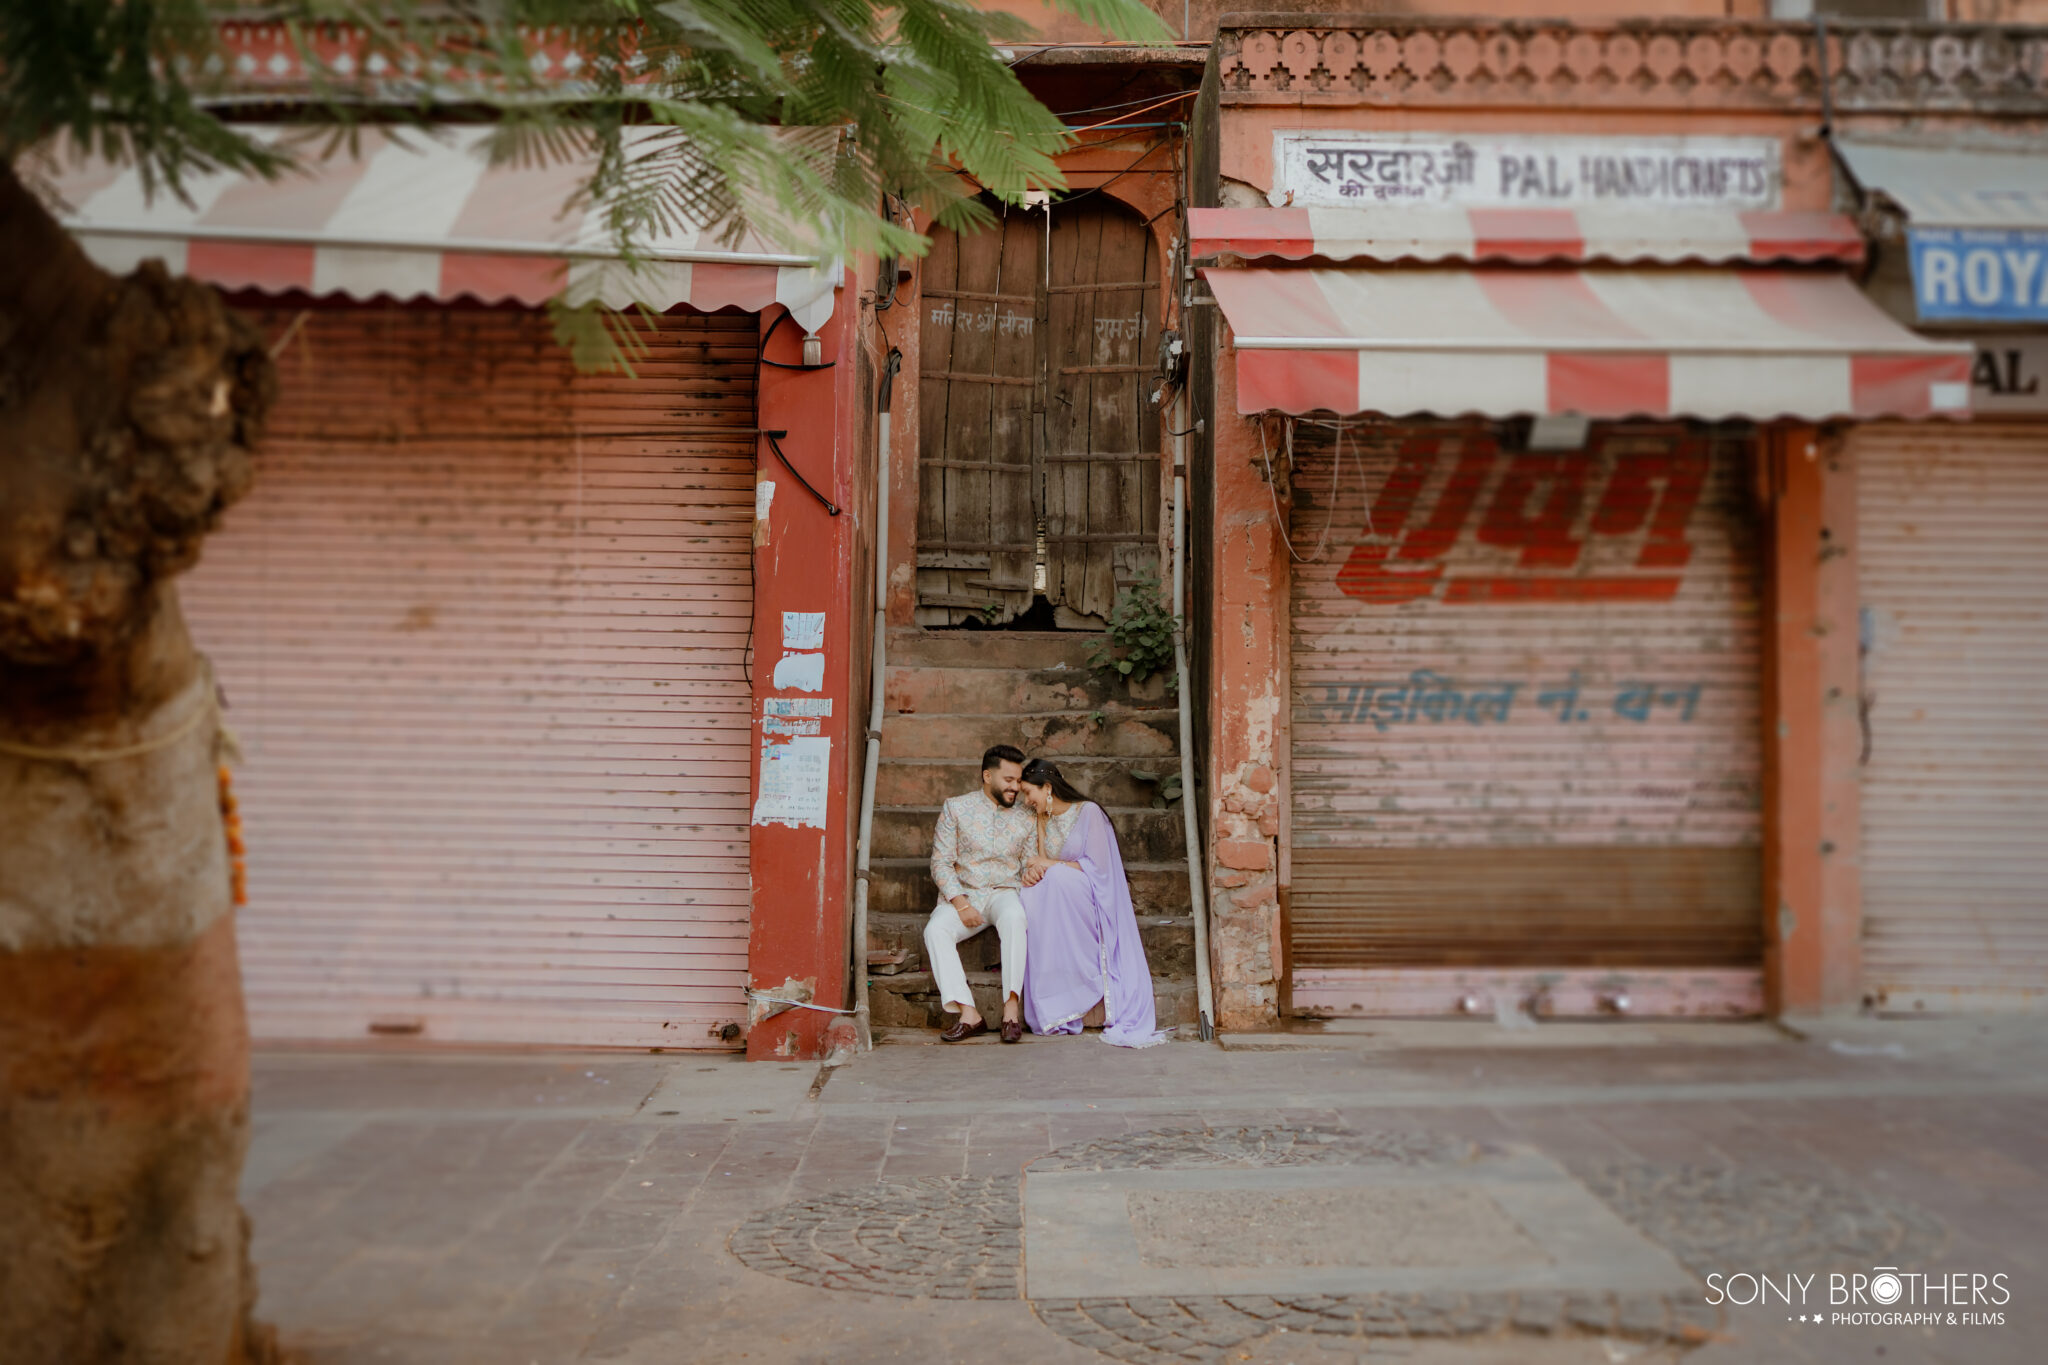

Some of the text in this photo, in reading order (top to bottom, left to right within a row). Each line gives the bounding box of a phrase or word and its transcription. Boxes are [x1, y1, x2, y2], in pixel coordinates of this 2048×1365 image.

[1499, 155, 1766, 198] PAL HANDICRAFTS
[1339, 179, 1365, 198] की
[1094, 318, 1125, 340] राम
